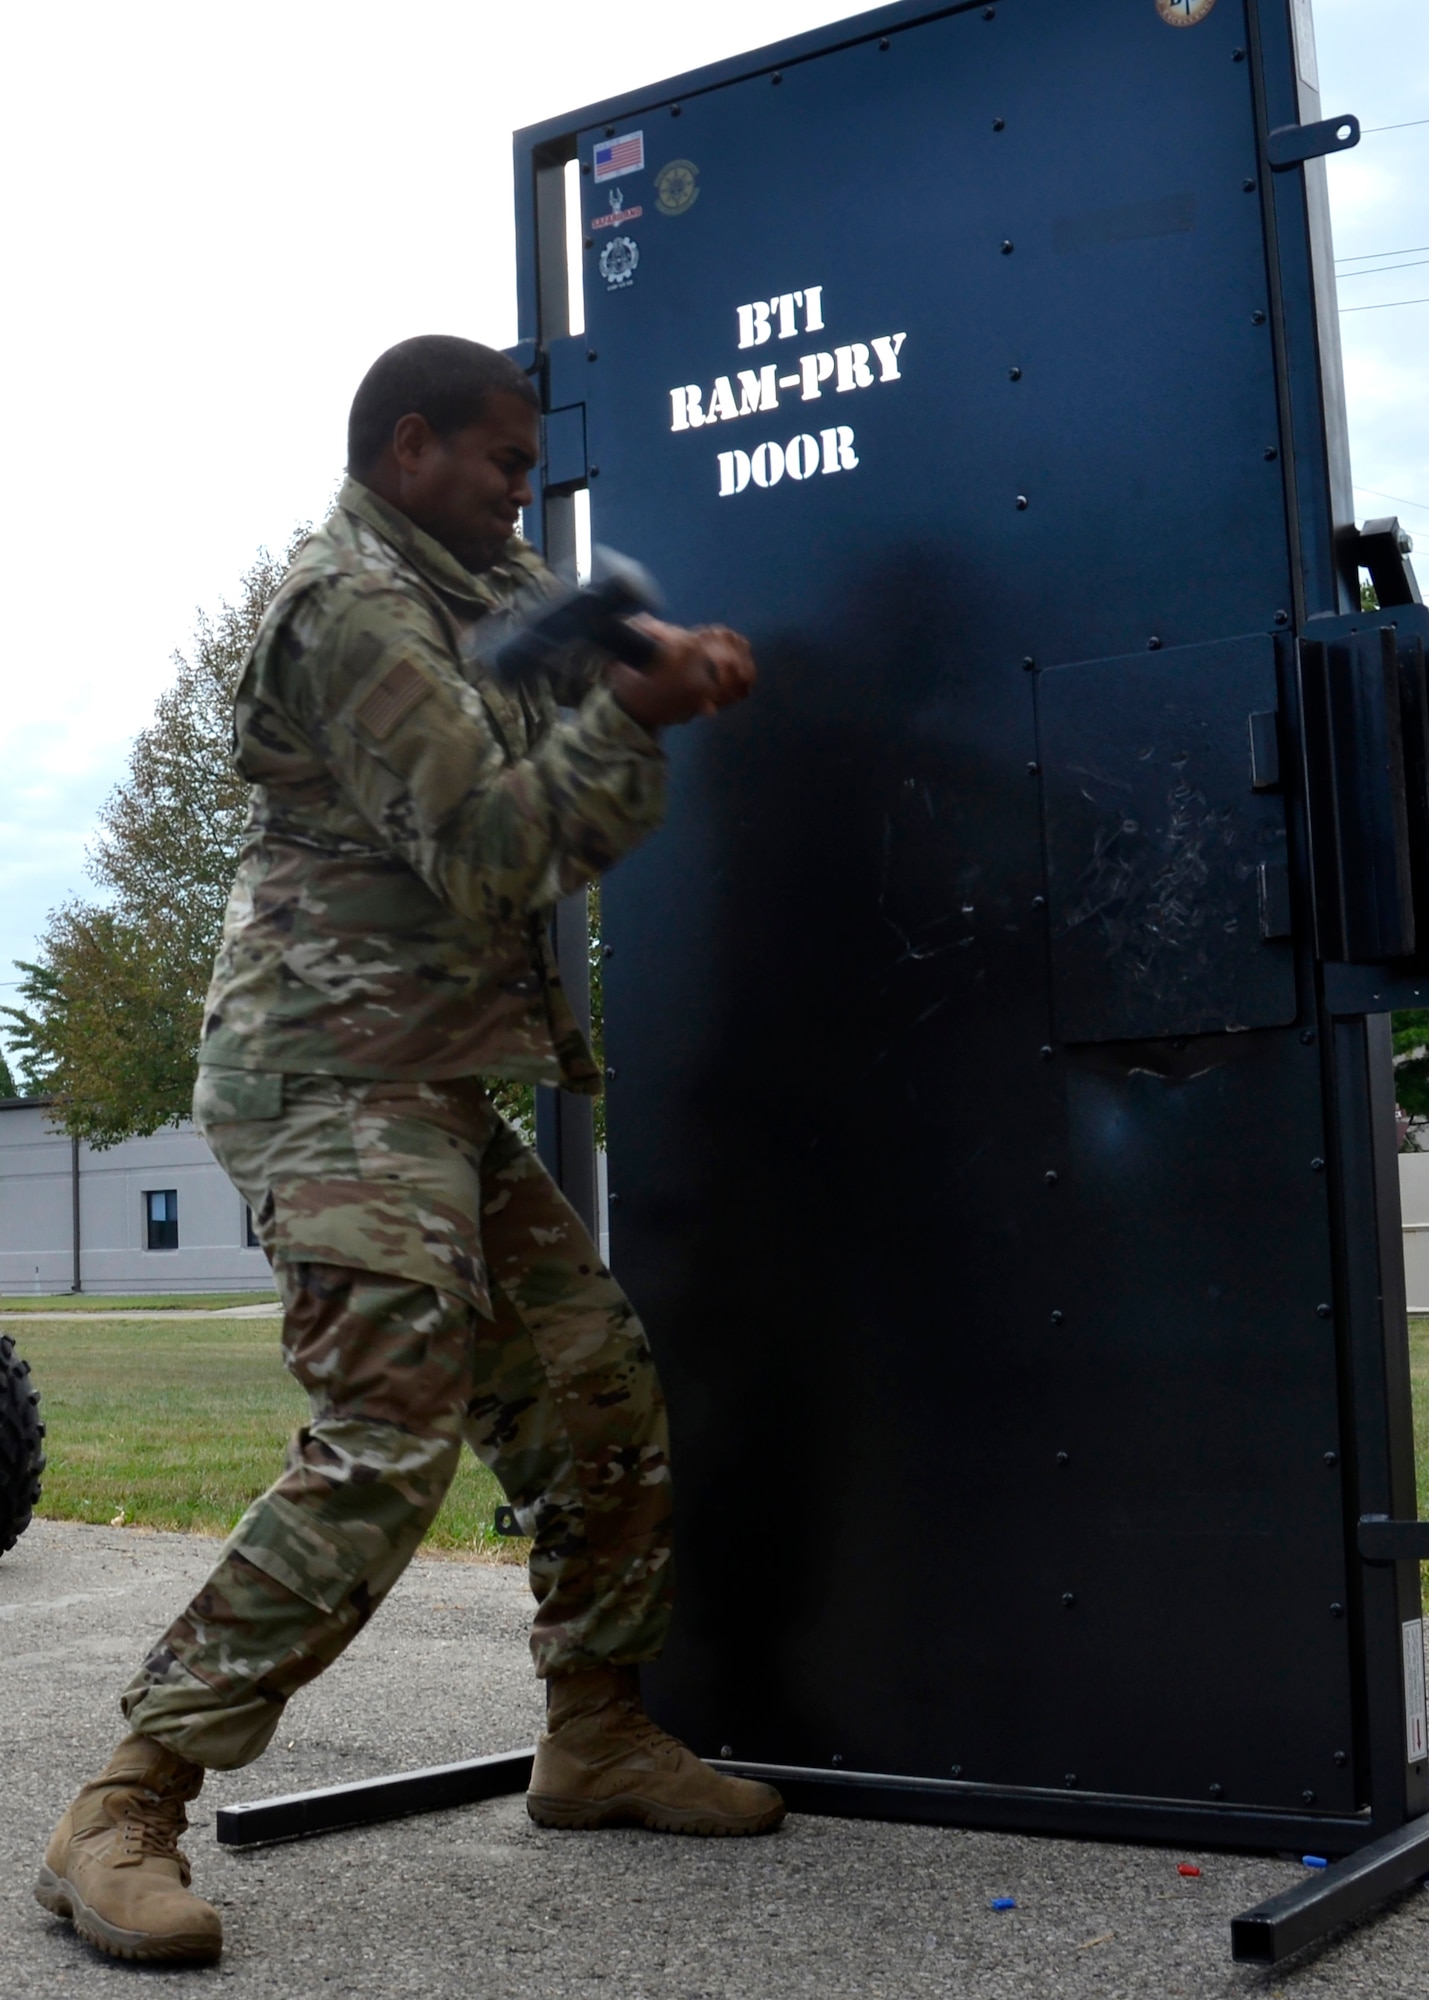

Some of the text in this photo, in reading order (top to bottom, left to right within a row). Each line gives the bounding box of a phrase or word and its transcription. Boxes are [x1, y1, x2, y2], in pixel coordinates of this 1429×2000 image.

[736, 285, 825, 350] BTI
[669, 331, 907, 432] RAM-PRY
[716, 425, 860, 497] DOOR
